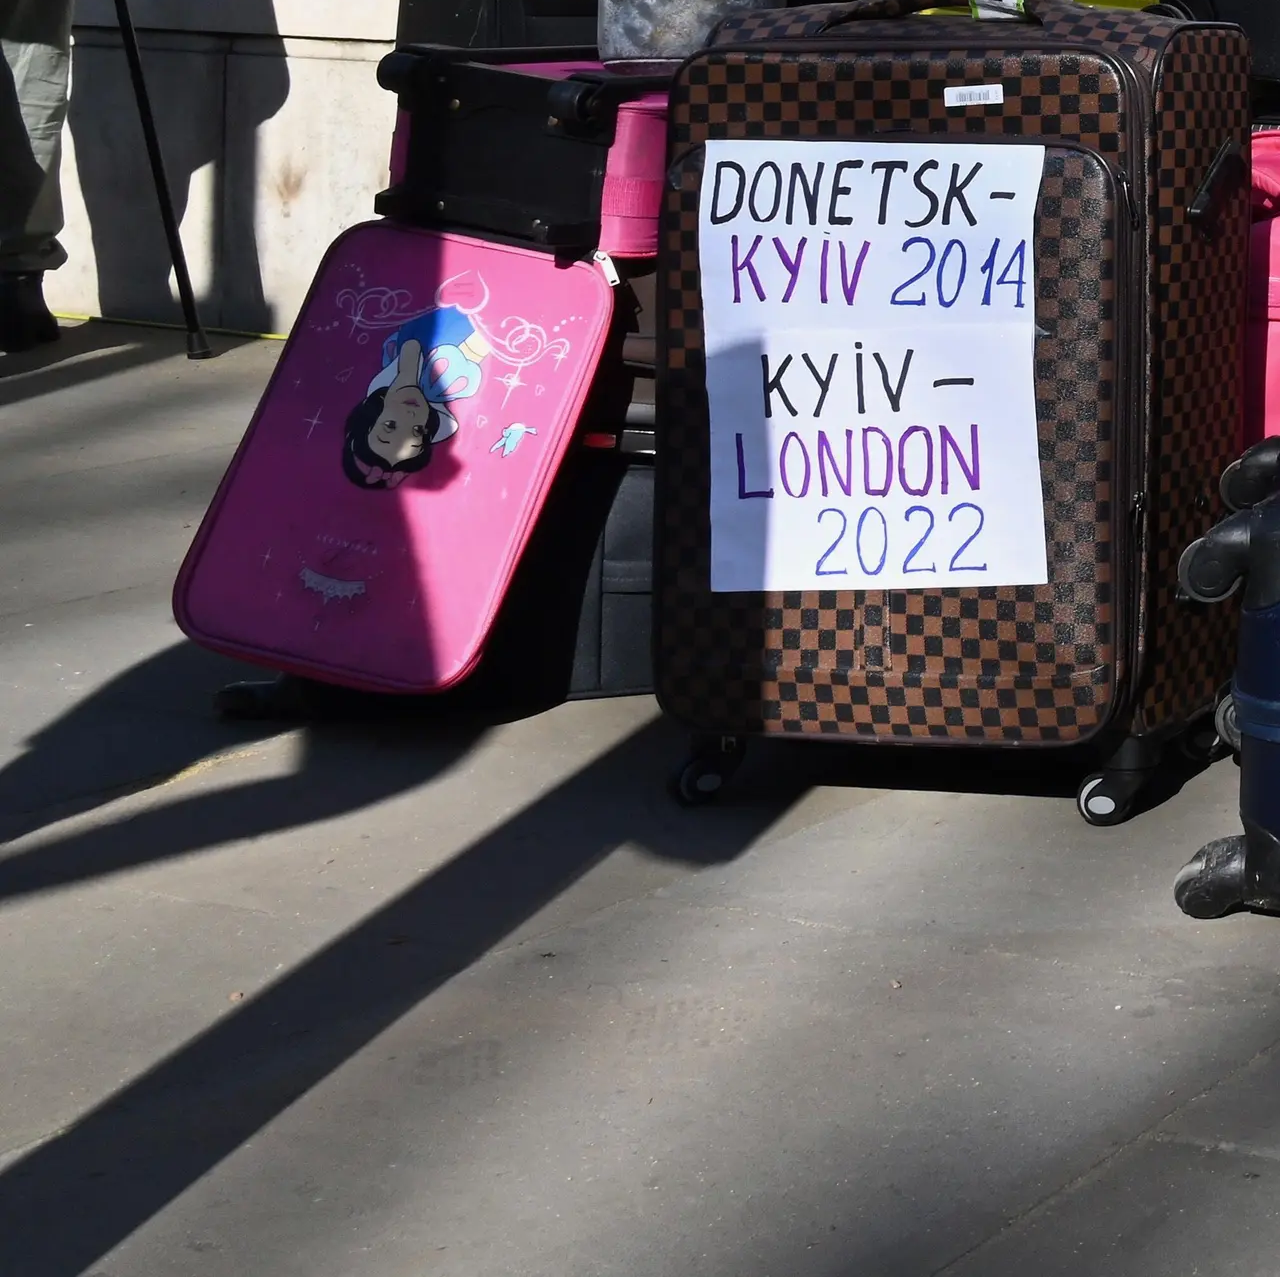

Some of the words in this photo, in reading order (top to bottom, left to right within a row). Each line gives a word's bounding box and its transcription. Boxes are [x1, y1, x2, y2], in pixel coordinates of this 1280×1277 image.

[711, 159, 1016, 226] DONETSK-
[731, 232, 871, 306] KYIV
[890, 236, 1027, 309] 2014
[736, 424, 980, 499] LONDON
[815, 503, 987, 576] 2022
